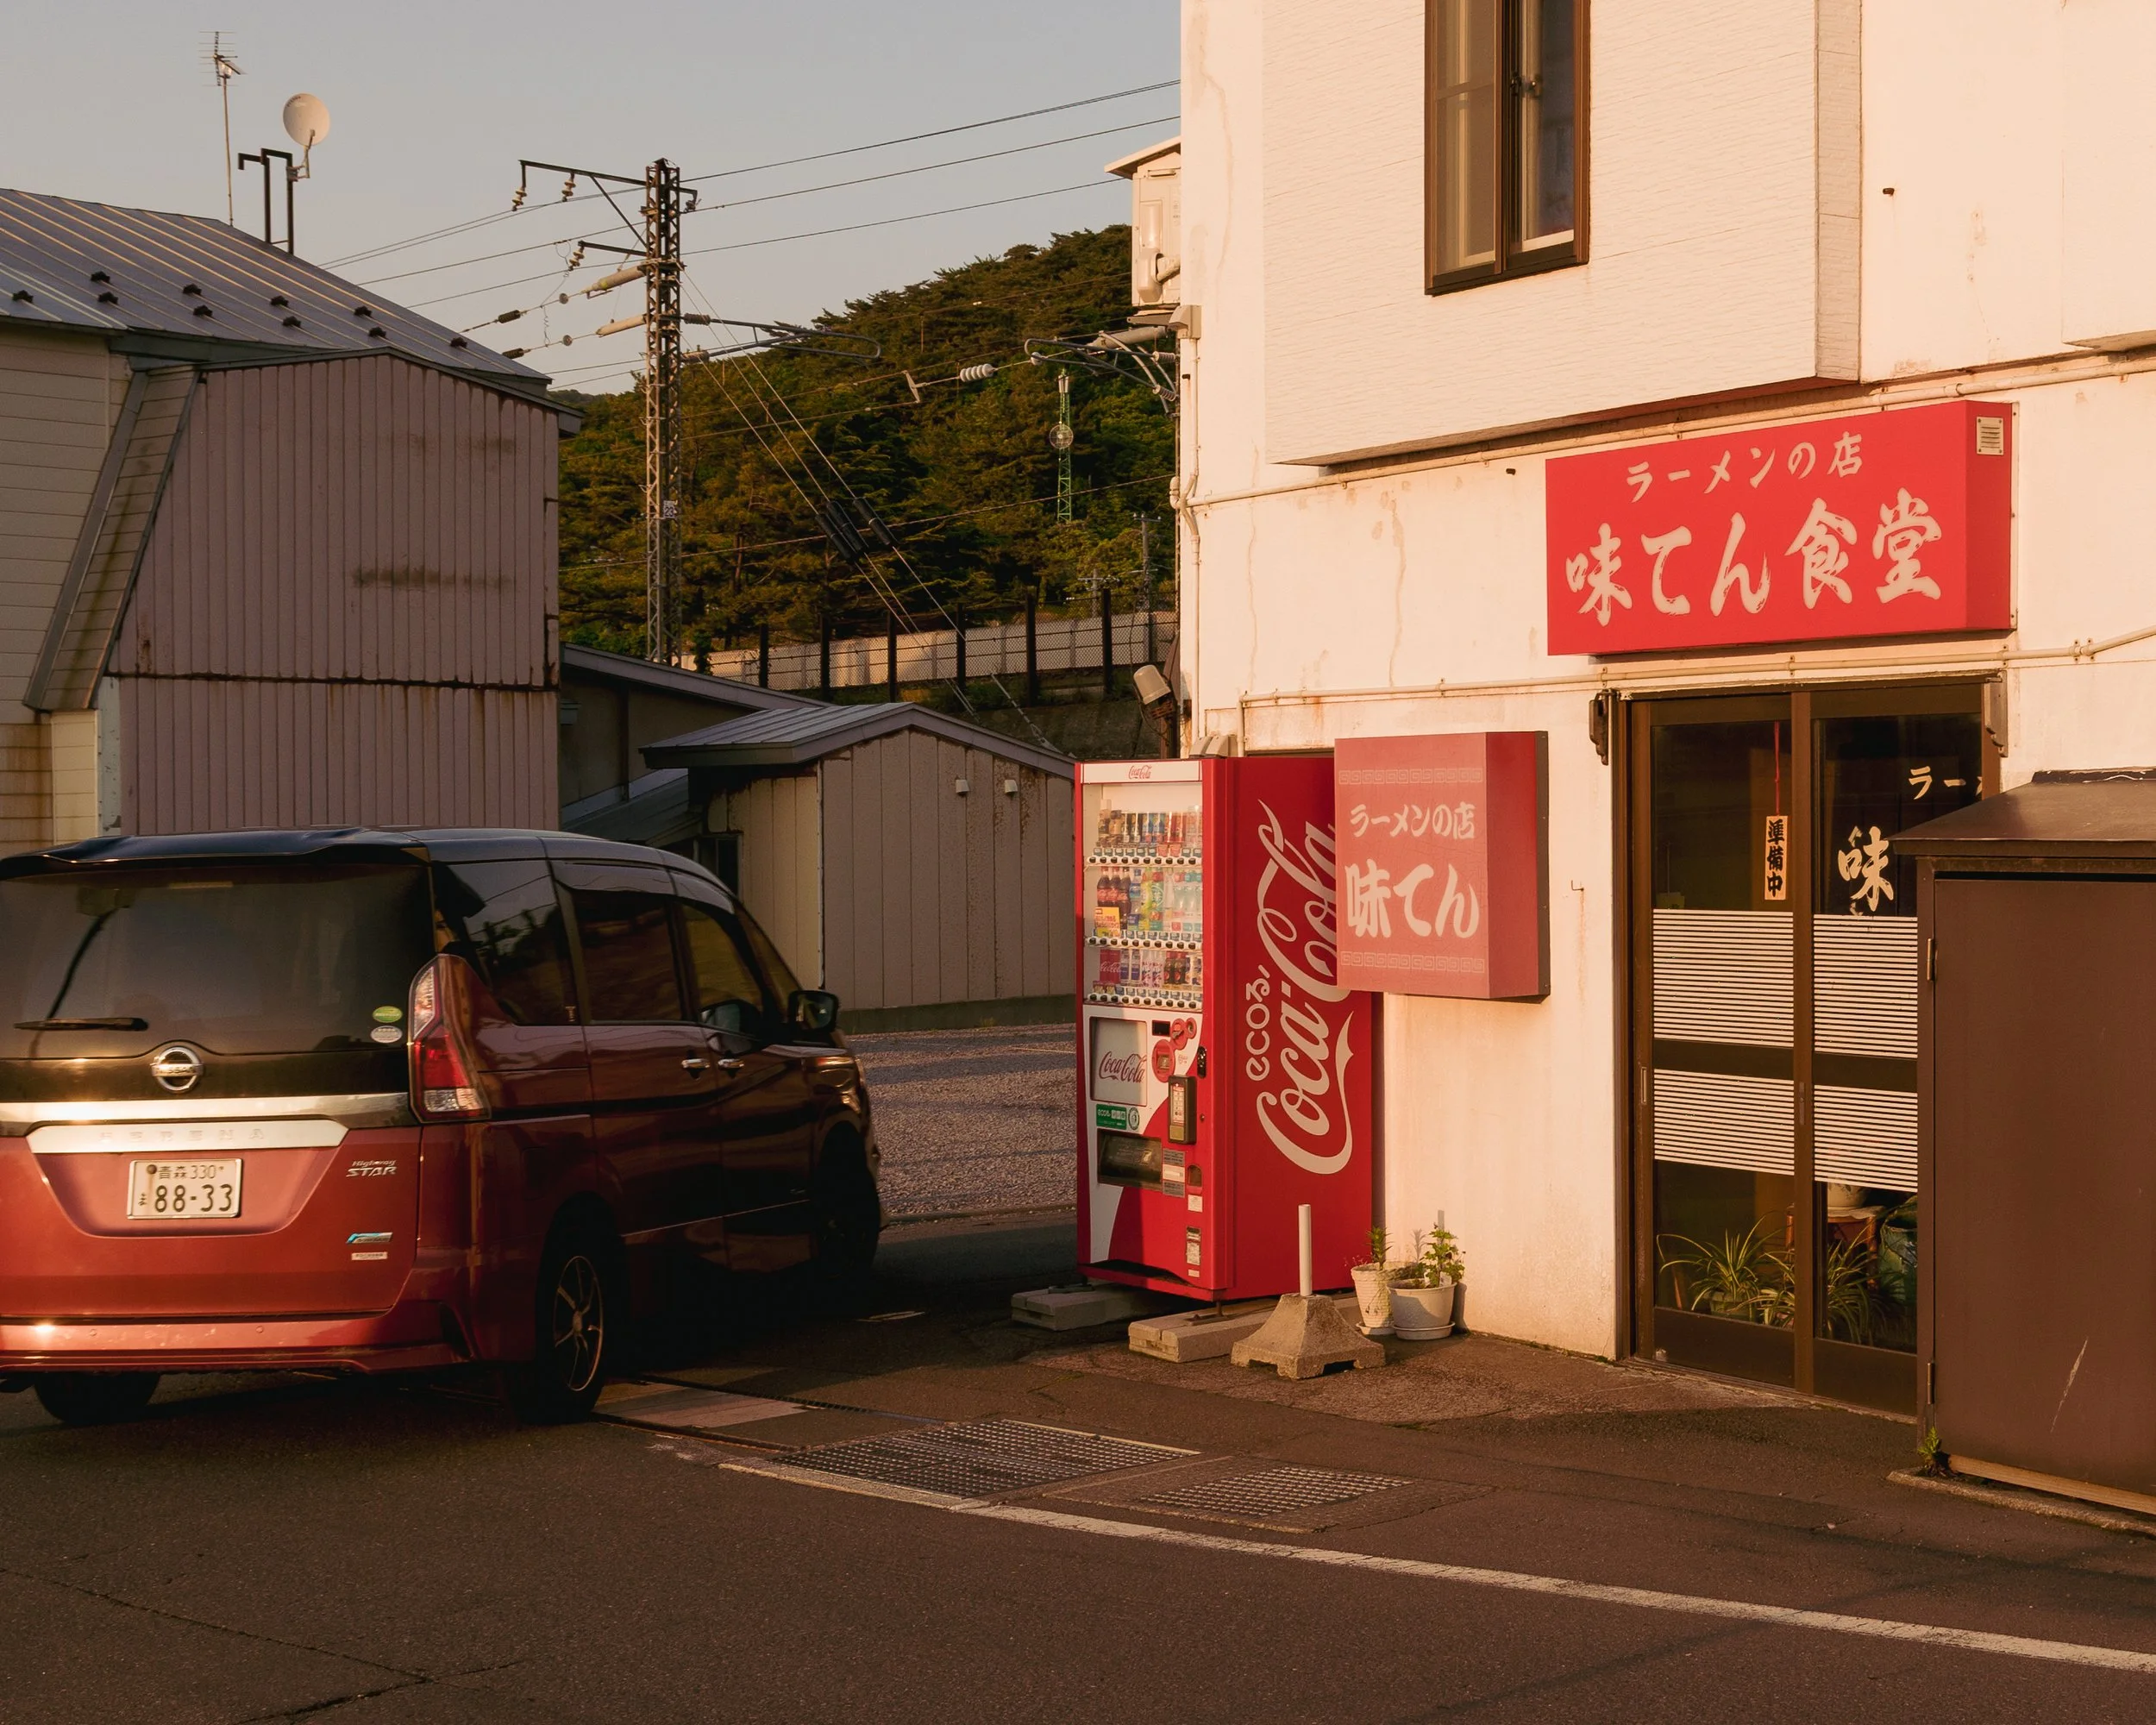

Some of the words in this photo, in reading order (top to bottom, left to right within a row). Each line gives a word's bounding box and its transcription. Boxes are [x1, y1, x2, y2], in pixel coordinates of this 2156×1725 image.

[1626, 430, 1862, 503] ラーメンの店
[1565, 486, 1943, 627] 味てん食堂
[1349, 800, 1476, 840] ラーメンの店
[1767, 819, 1785, 898] 準備中
[1838, 825, 1895, 913] 味
[1344, 858, 1480, 939] 味てん
[154, 1183, 234, 1214] 88-33
[346, 1166, 398, 1177] STAR
